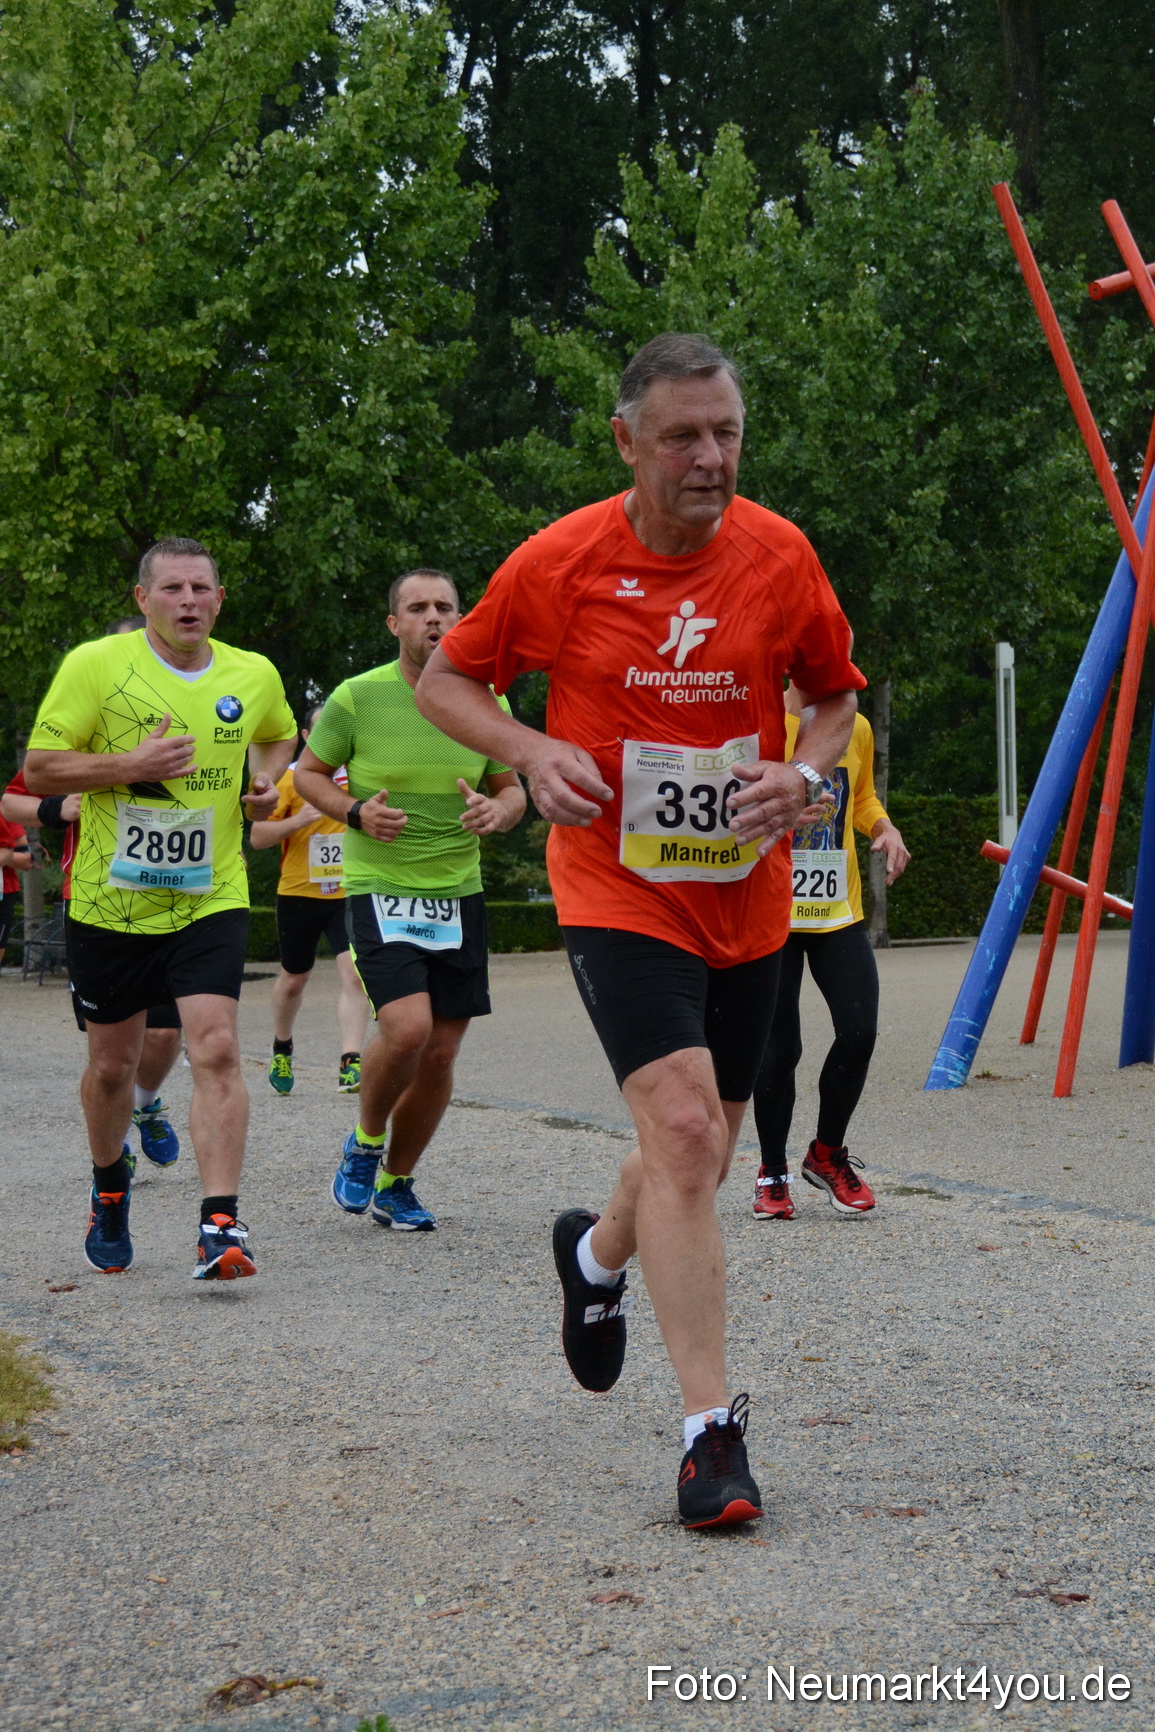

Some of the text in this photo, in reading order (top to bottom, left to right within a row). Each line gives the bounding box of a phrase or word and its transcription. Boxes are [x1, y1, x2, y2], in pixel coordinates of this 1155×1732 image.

[624, 666, 735, 689] funrunners
[661, 685, 750, 703] neumarkt
[214, 727, 243, 738] Partl
[636, 758, 685, 772] NeuerMarkt
[200, 767, 228, 779] NEXT
[185, 780, 205, 791] 100
[126, 825, 206, 864] 2890
[660, 842, 741, 864] Manfred
[140, 871, 185, 886] Rainer
[796, 905, 831, 917] Roland
[406, 924, 436, 939] Marco
